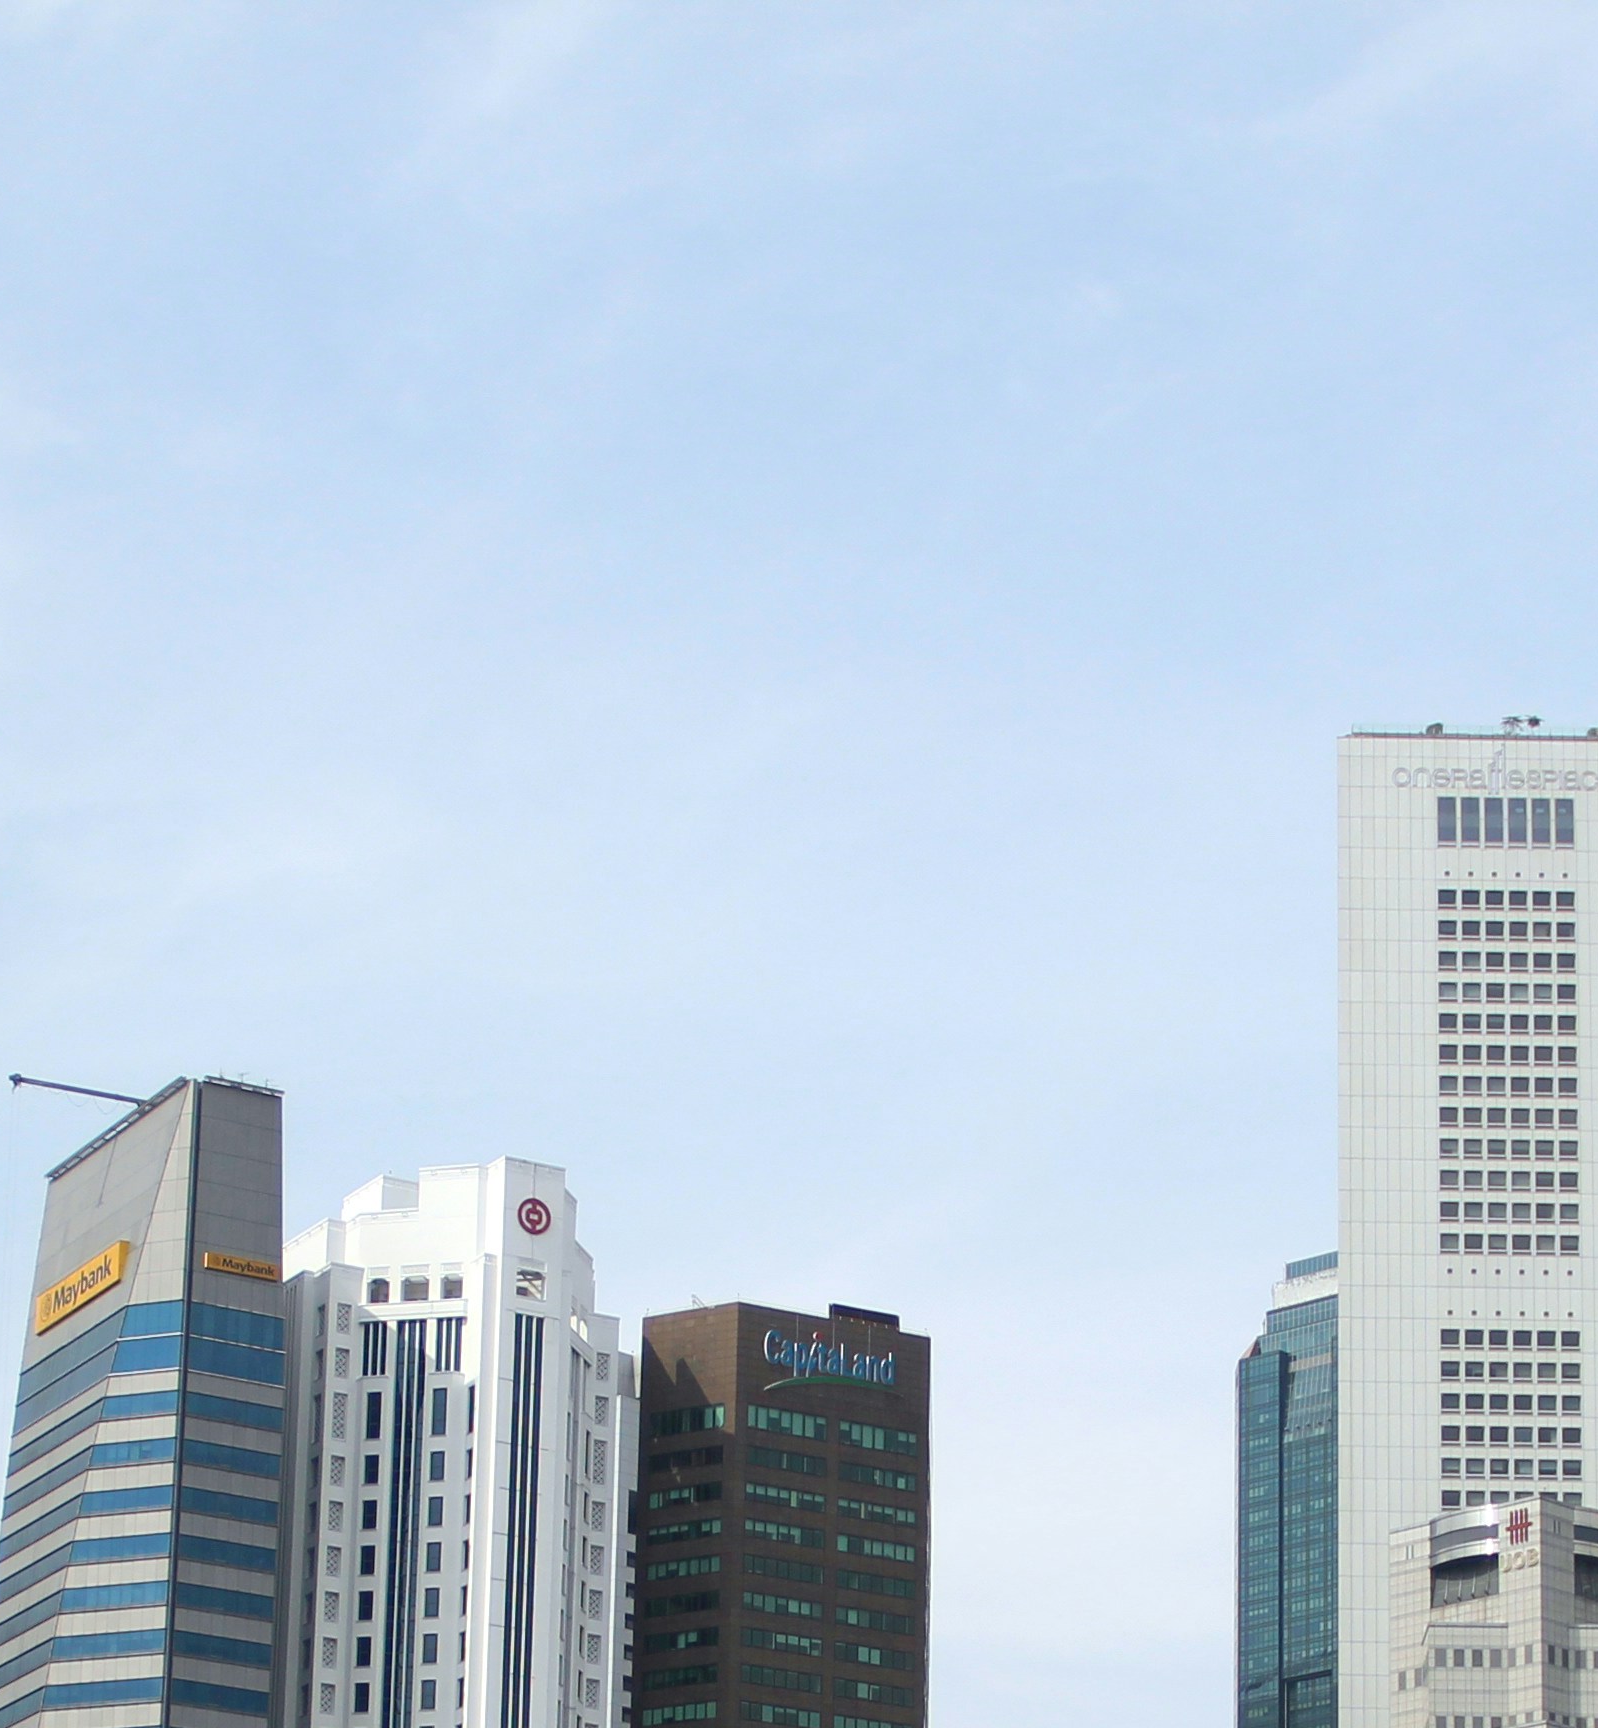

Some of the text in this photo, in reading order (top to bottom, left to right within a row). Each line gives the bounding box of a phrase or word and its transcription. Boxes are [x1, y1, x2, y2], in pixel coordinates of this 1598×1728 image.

[53, 1255, 112, 1313] Maybank
[221, 1257, 275, 1277] Maybank
[763, 1329, 896, 1386] CapitaLand
[1500, 1548, 1539, 1573] UOB
